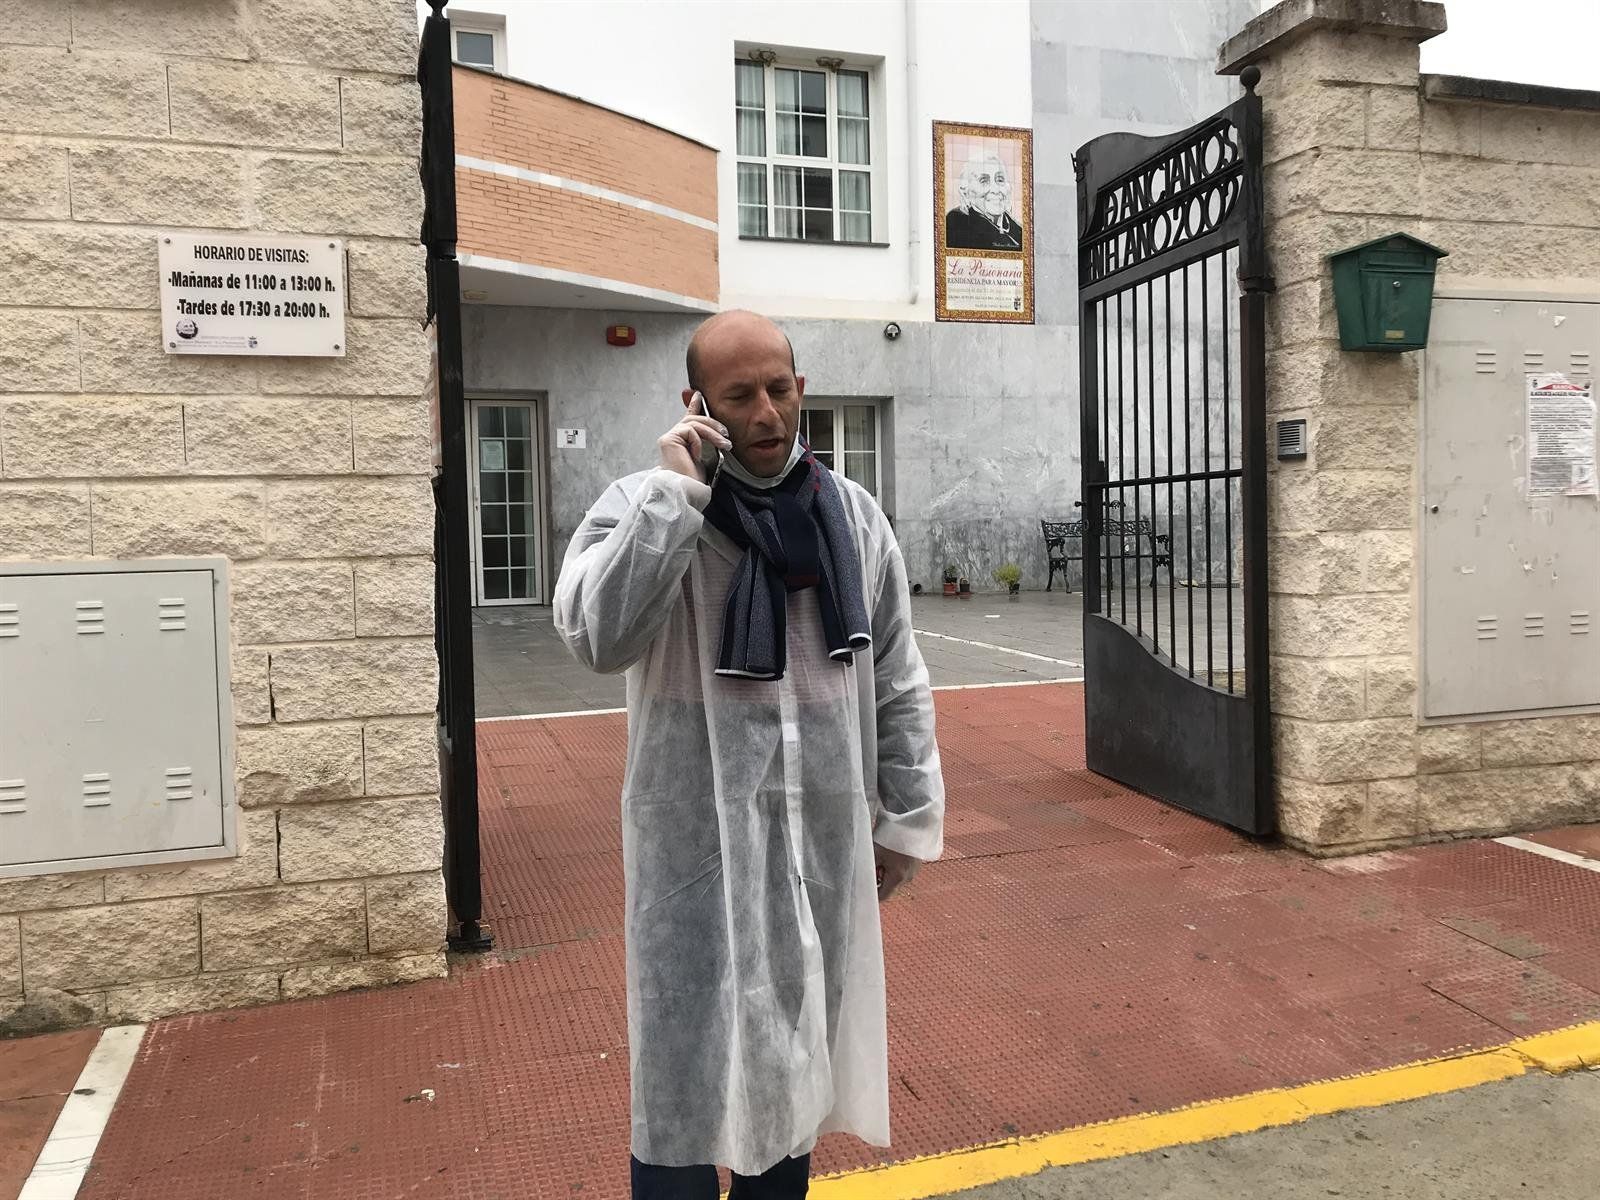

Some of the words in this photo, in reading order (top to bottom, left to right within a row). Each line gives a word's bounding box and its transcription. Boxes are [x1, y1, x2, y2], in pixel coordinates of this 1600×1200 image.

[194, 245, 245, 261] HORARIO
[248, 247, 263, 262] DE
[265, 248, 309, 263] VISITAS:
[168, 271, 224, 289] -Mañanas
[226, 273, 241, 289] de
[245, 274, 277, 291] 11:00
[280, 278, 287, 291] a
[290, 275, 321, 292] 13:00
[325, 276, 336, 292] h.
[176, 299, 217, 316] -Tardes
[220, 299, 235, 316] de
[239, 300, 271, 317] 17:30
[274, 305, 281, 317] a
[284, 301, 315, 318] 20:00
[319, 302, 330, 318] h.
